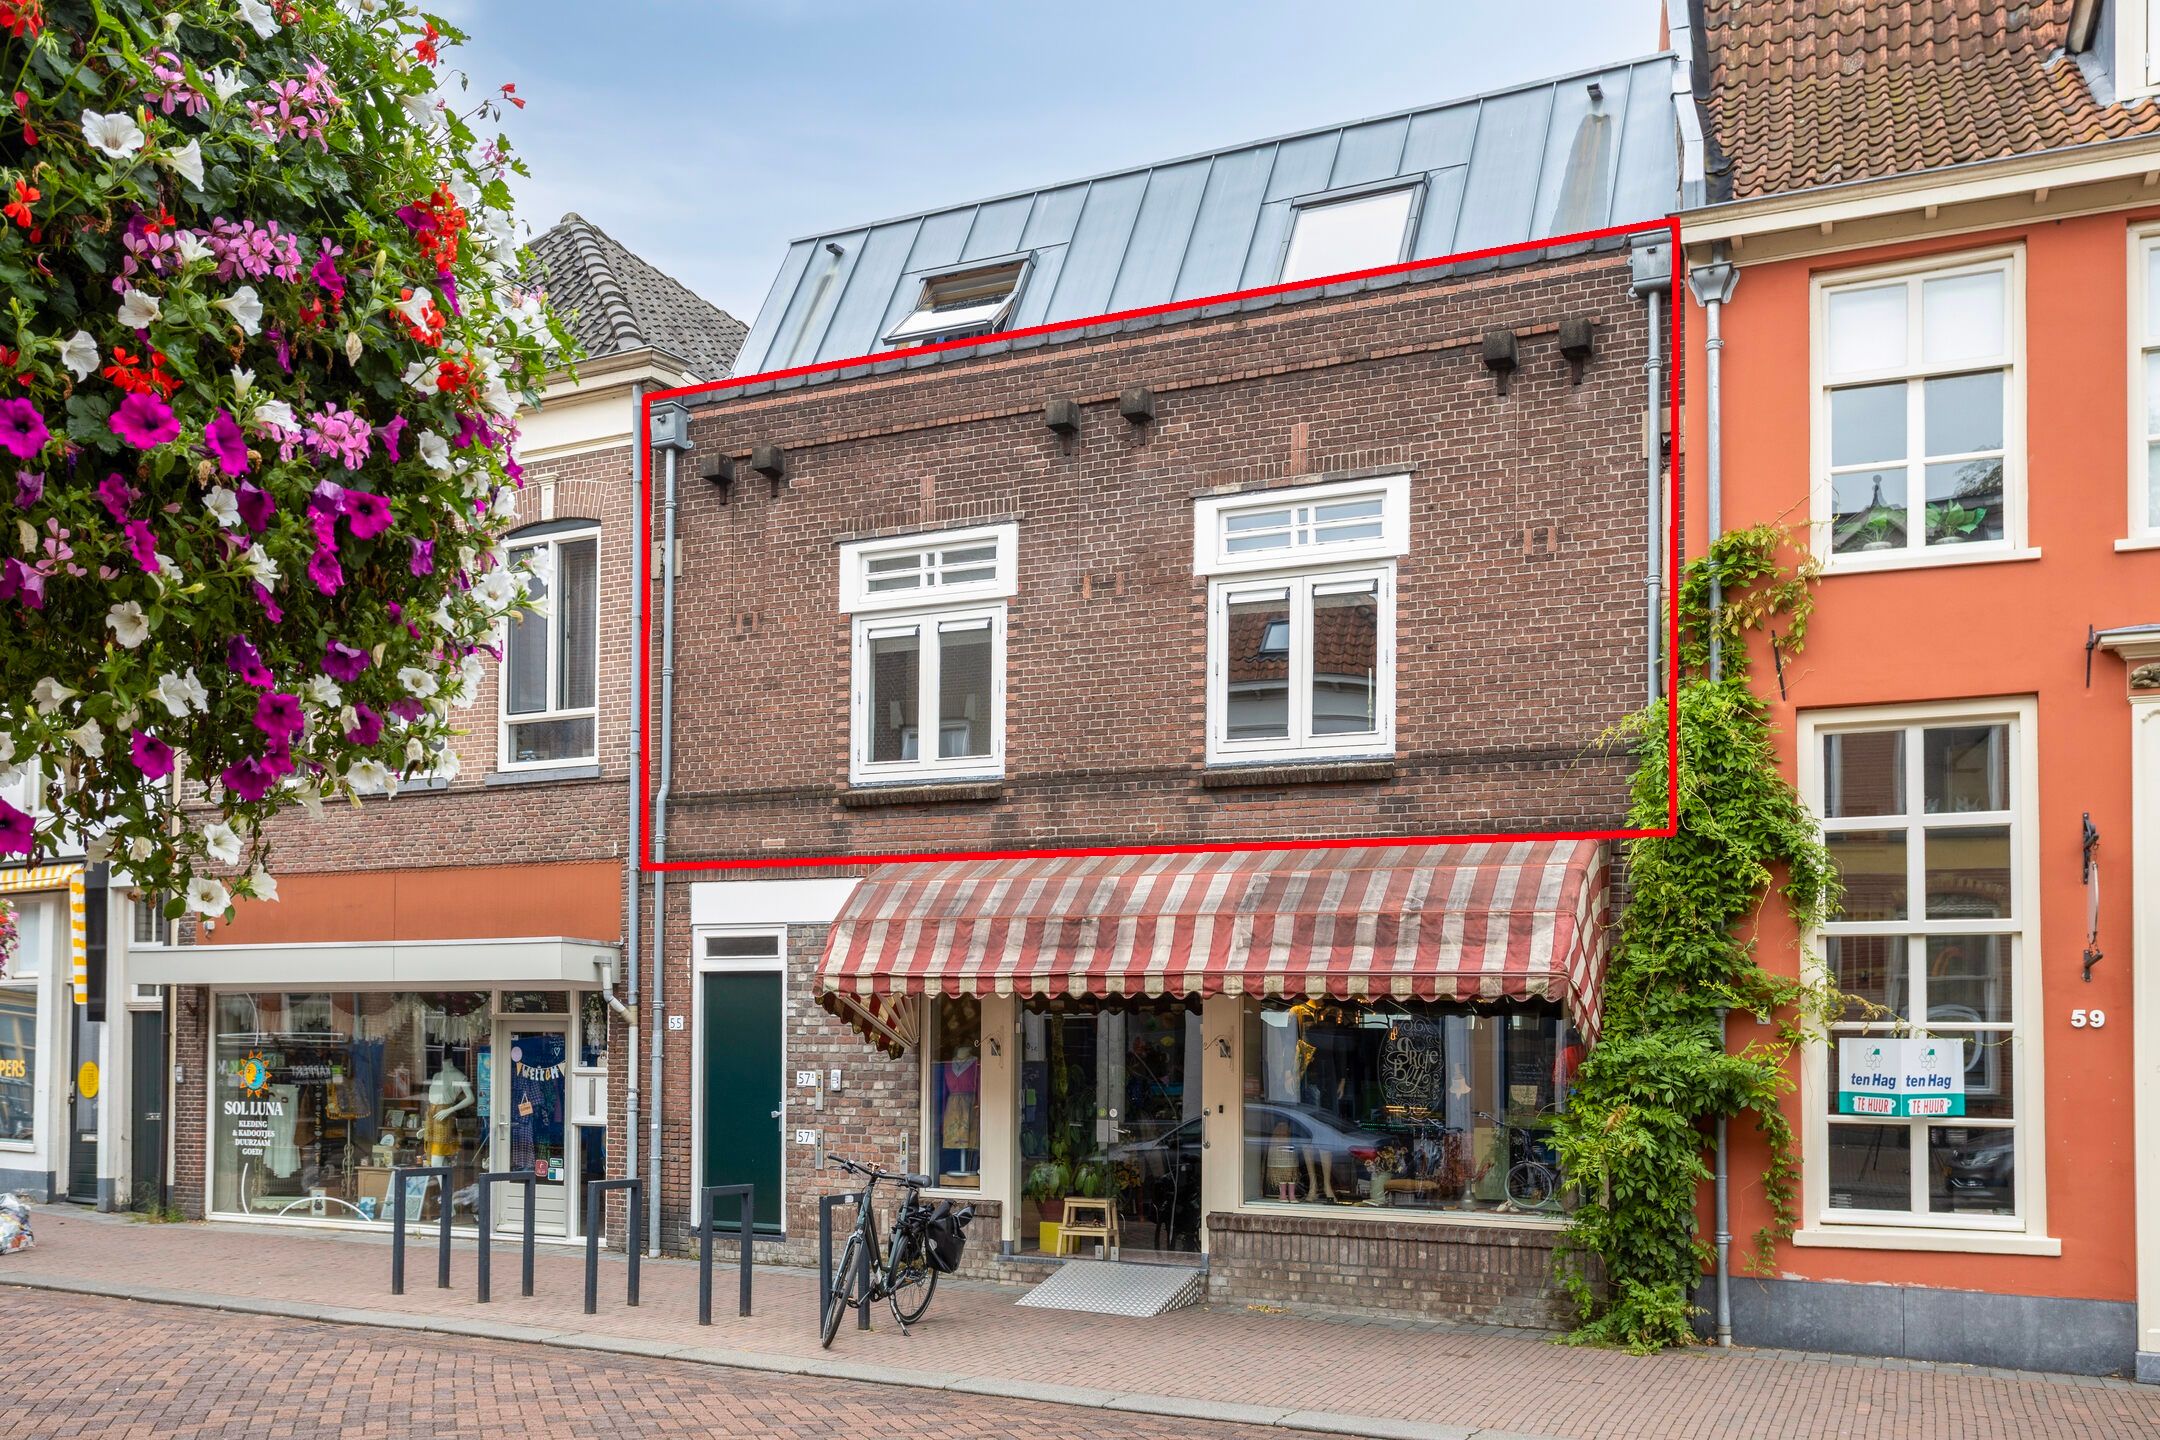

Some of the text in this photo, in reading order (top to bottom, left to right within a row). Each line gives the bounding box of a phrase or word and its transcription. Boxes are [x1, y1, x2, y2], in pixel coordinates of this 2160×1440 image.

[670, 1017, 682, 1029] 55
[2071, 1009, 2105, 1028] 59
[522, 1064, 560, 1082] WELKOM
[1851, 1073, 1897, 1089] ten Hag
[1906, 1074, 1952, 1089] ten Hag
[224, 1101, 283, 1116] SOL LUNA
[1858, 1097, 1889, 1113] TE HUUR
[1913, 1099, 1945, 1113] TE HUUR
[238, 1120, 267, 1128] KLEDING
[238, 1129, 276, 1139] KADOOTJES
[234, 1138, 271, 1147] DUURZAAM
[242, 1148, 264, 1156] GOED!
